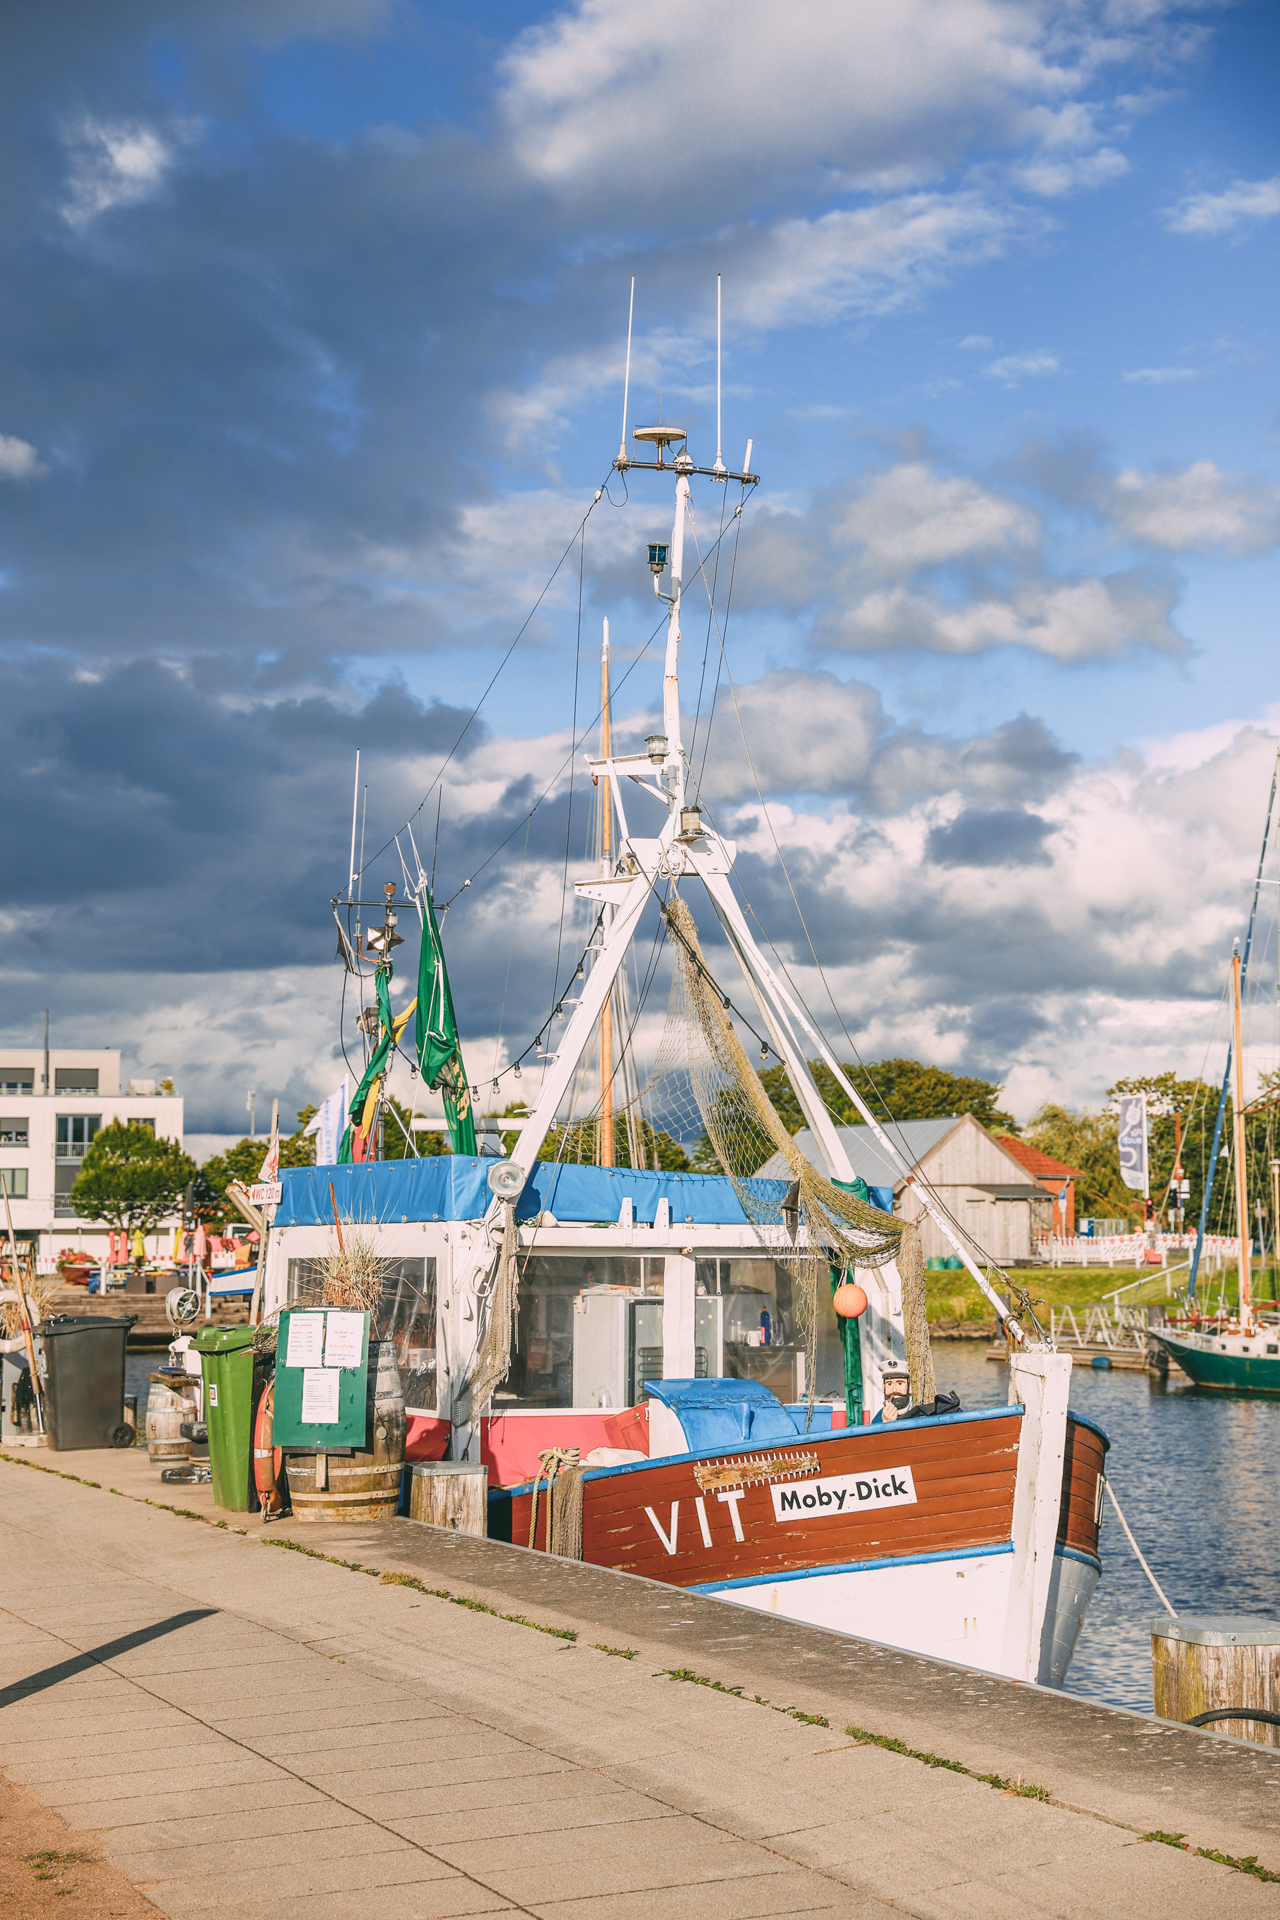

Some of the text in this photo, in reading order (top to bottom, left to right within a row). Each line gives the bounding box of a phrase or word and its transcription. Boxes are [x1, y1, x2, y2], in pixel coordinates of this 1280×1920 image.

[255, 1187, 280, 1200] WC 120 m
[780, 1475, 909, 1512] Moby-Dick
